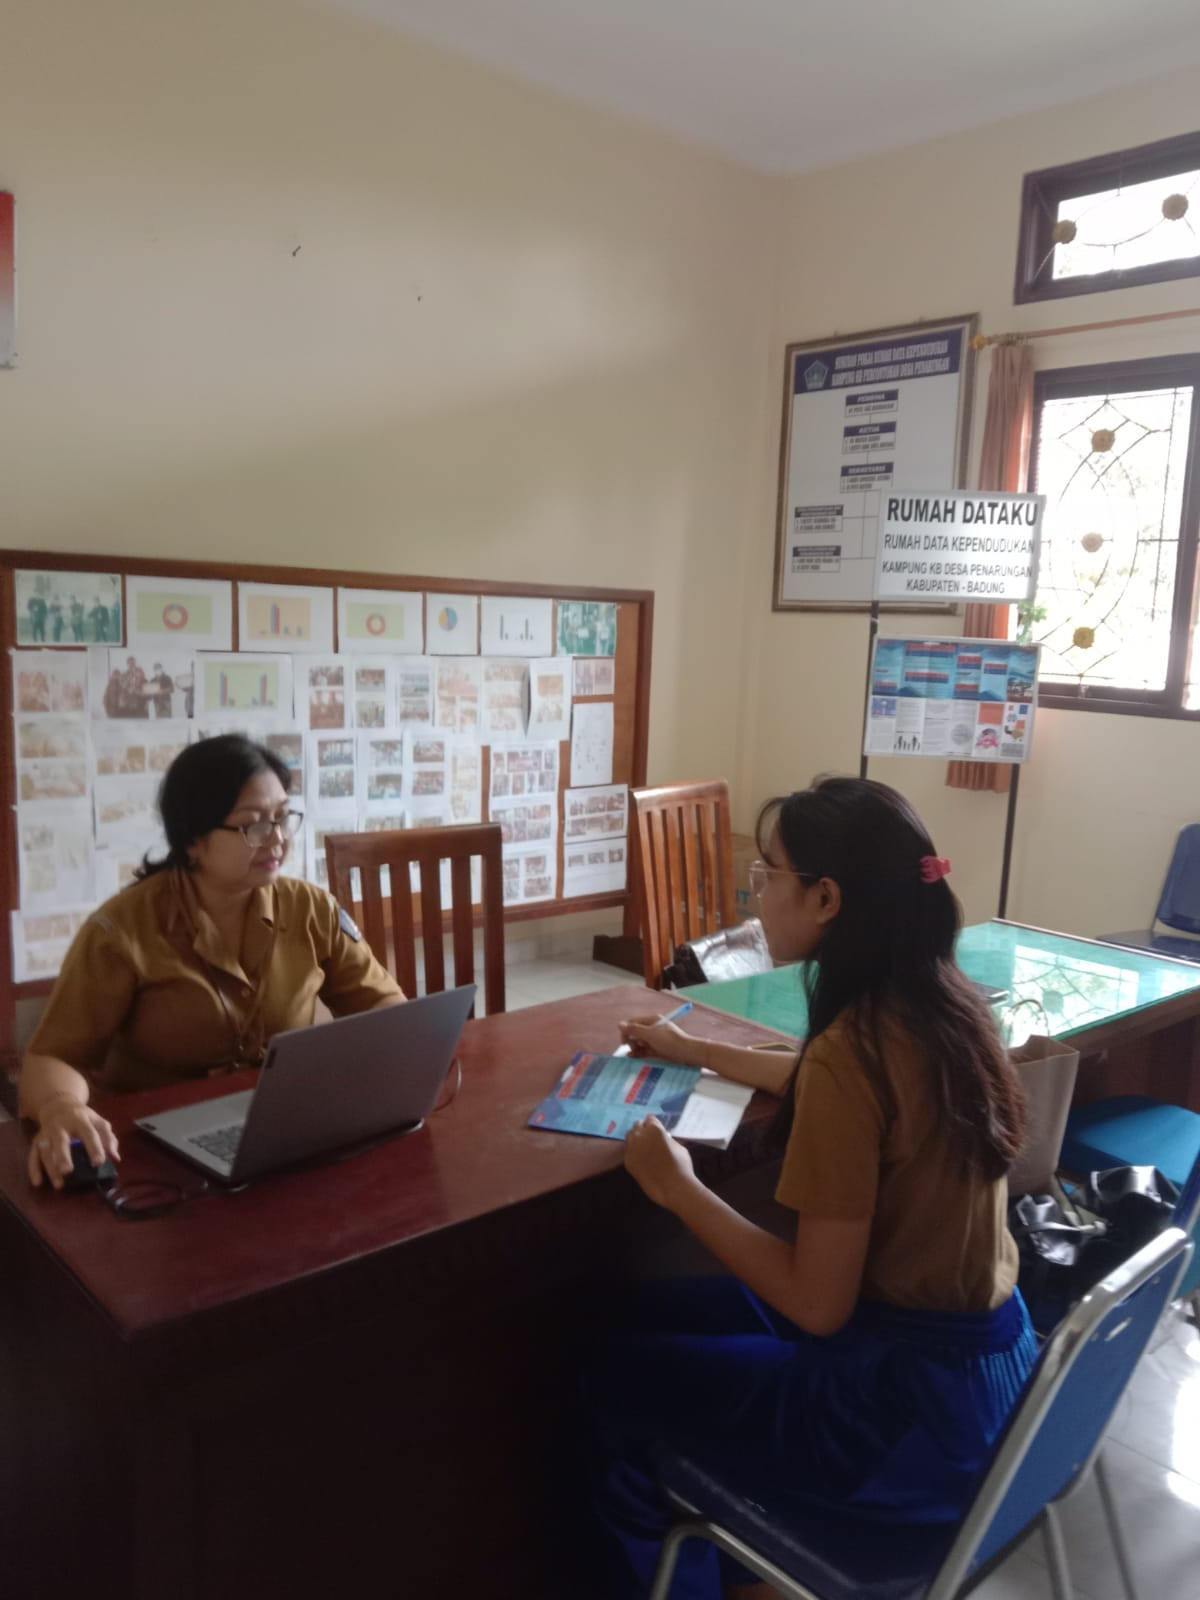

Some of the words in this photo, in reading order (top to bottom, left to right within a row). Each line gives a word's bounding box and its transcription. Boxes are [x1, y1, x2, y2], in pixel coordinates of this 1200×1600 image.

[887, 498, 956, 523] RUMAH
[962, 500, 1038, 526] DATAKU
[884, 534, 920, 550] RUMAH
[924, 535, 949, 551] DATA
[951, 536, 1034, 554] KEPENDUDUKAN
[882, 561, 927, 574] KAMPUNG
[930, 562, 942, 574] KB
[945, 563, 968, 576] DESA
[970, 564, 1032, 577] PENARUNGAN
[906, 579, 959, 593] KABUPATEN
[967, 581, 1005, 593] BADUNG
